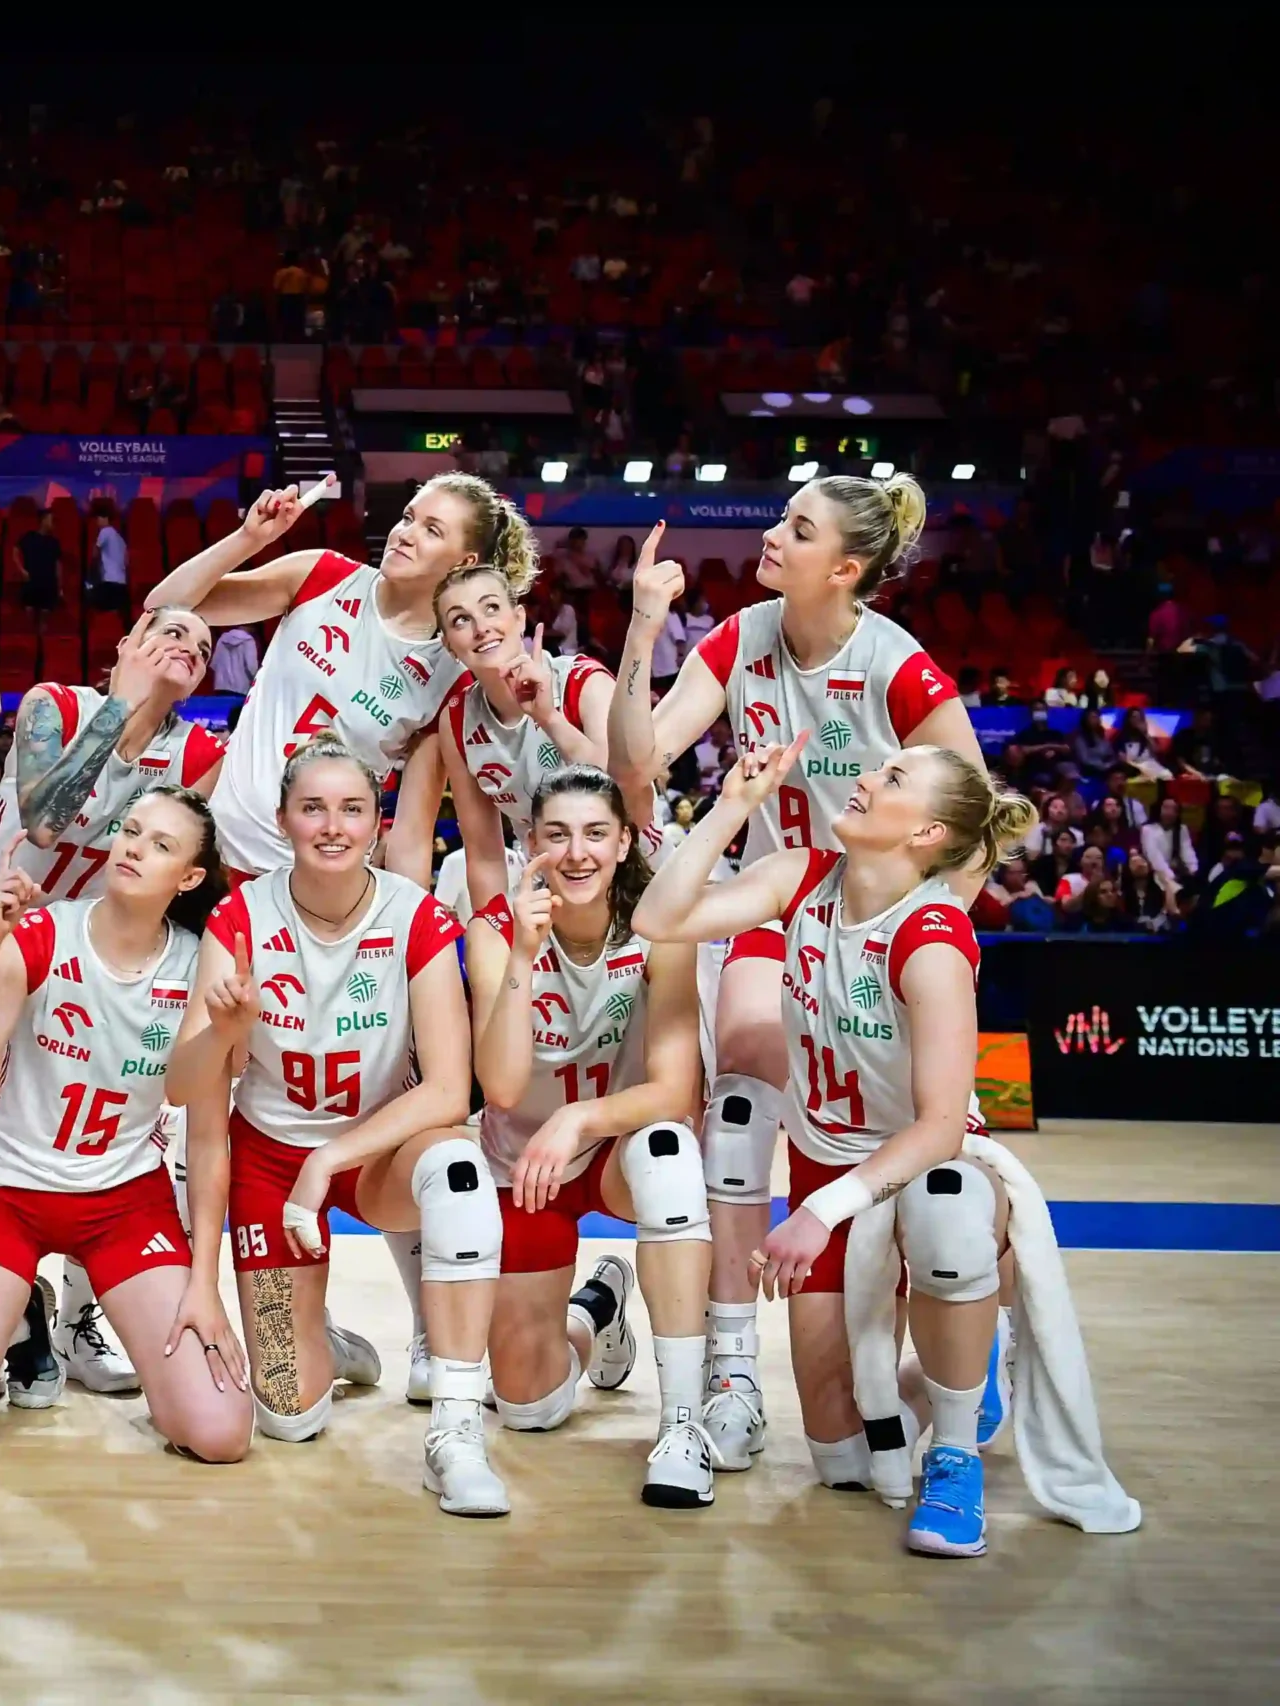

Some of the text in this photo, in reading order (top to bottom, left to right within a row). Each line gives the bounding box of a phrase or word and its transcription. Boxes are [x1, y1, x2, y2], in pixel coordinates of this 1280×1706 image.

[79, 441, 166, 453] VOLLEYBALL
[79, 454, 166, 463] NATIONS LEAGUE
[690, 505, 776, 517] VOLLEYBALL
[296, 640, 337, 677] ORLEN
[399, 659, 428, 687] POLSKA
[351, 689, 393, 727] plus
[138, 765, 165, 778] POLSK
[806, 756, 861, 778] plus
[778, 784, 813, 849] 9
[41, 841, 111, 899] 17
[355, 948, 395, 960] POLSKA
[608, 963, 646, 981] POLSKA
[151, 999, 188, 1010] POLSKA
[258, 1010, 306, 1032] RLEN
[337, 1011, 389, 1037] plus
[837, 1016, 893, 1041] plus
[36, 1034, 92, 1062] ORLEN
[533, 1030, 570, 1049] LEN
[597, 1030, 625, 1049] pl
[1138, 1037, 1250, 1057] NATIONS
[121, 1057, 167, 1077] plus
[281, 1050, 361, 1118] 95
[800, 1034, 866, 1127] 14
[52, 1082, 129, 1156] 15
[236, 1223, 269, 1259] 95
